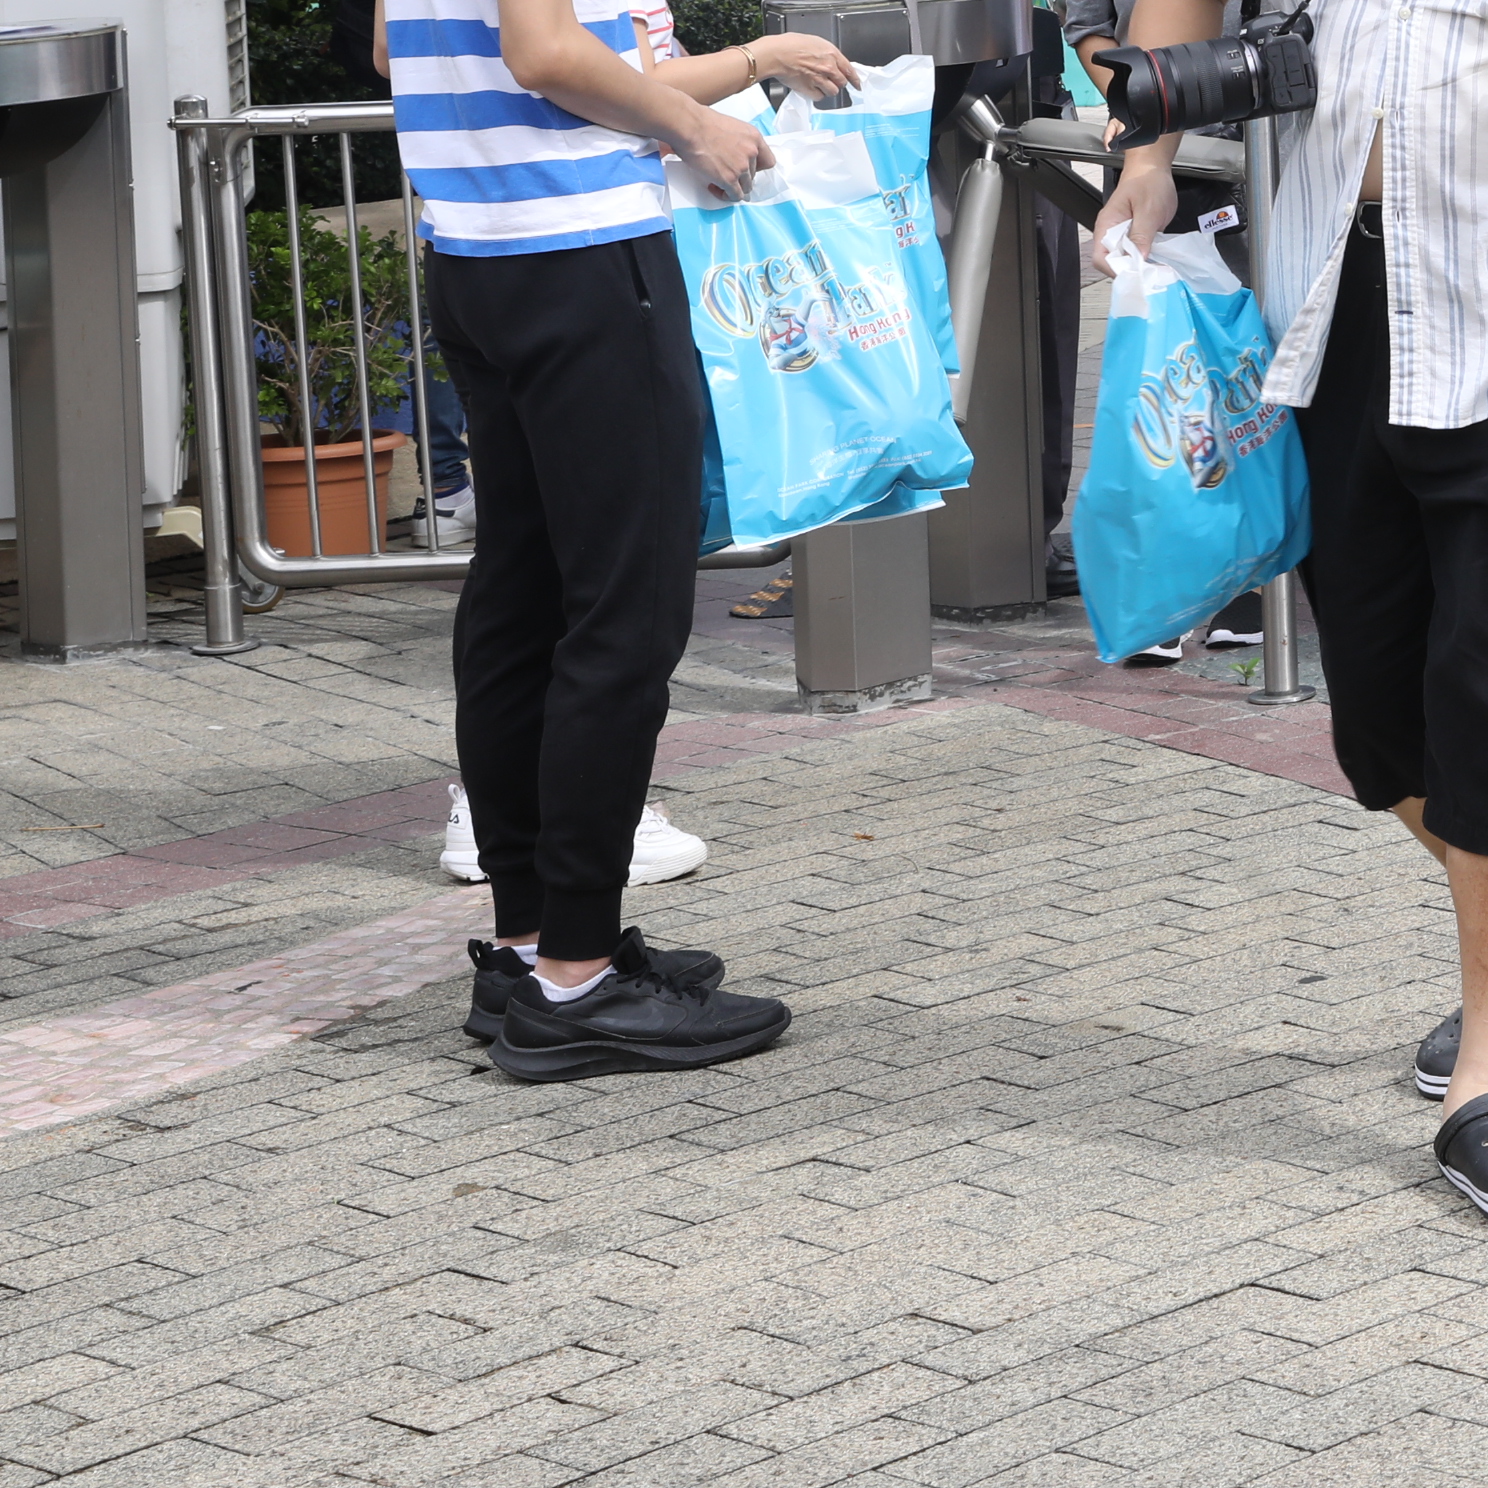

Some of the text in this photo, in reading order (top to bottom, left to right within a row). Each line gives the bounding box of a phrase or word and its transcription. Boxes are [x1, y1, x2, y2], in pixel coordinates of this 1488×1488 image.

[1204, 214, 1233, 229] ellesse
[848, 319, 877, 341] Hong
[1131, 339, 1206, 468] Ocea
[870, 436, 896, 444] OCEAN
